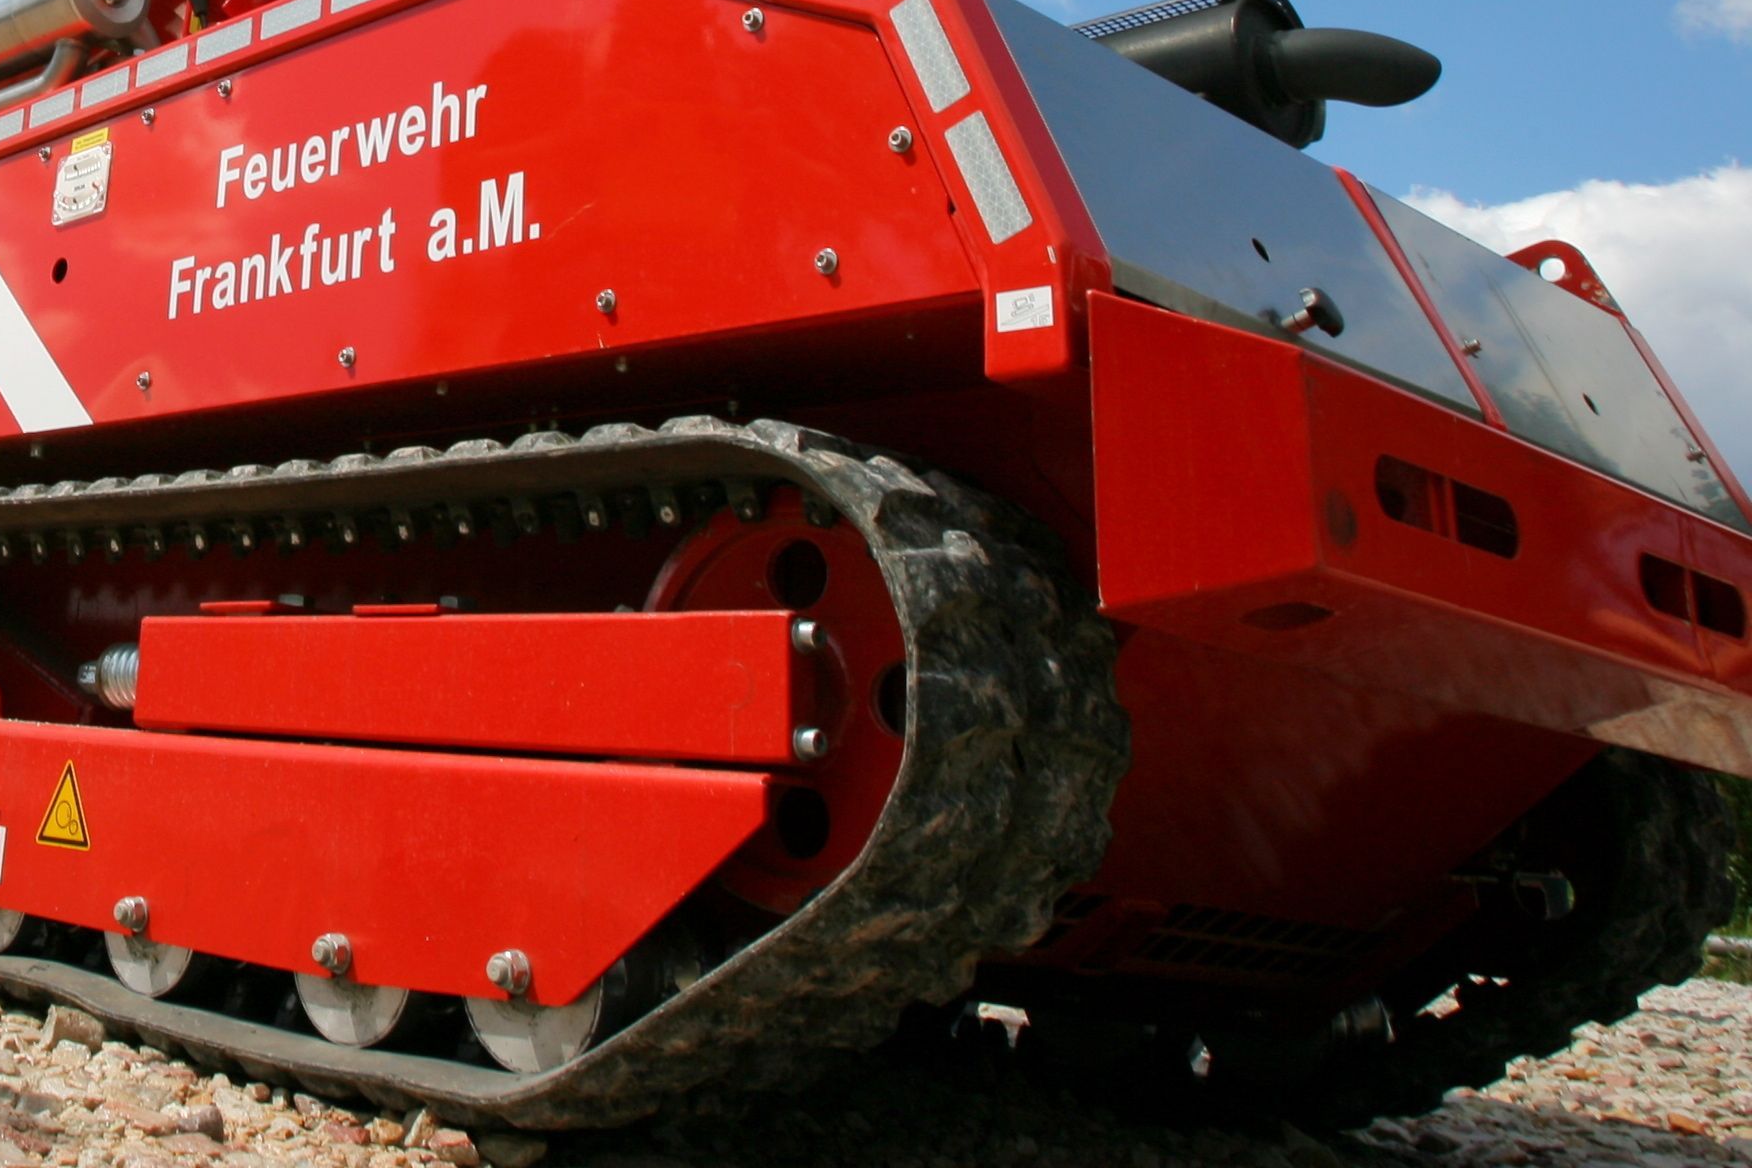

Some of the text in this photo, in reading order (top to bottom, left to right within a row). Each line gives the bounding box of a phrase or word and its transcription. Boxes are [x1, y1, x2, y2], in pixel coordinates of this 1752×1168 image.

[215, 80, 489, 210] Feuerwehr
[167, 170, 541, 321] Frankfurt a.M.
